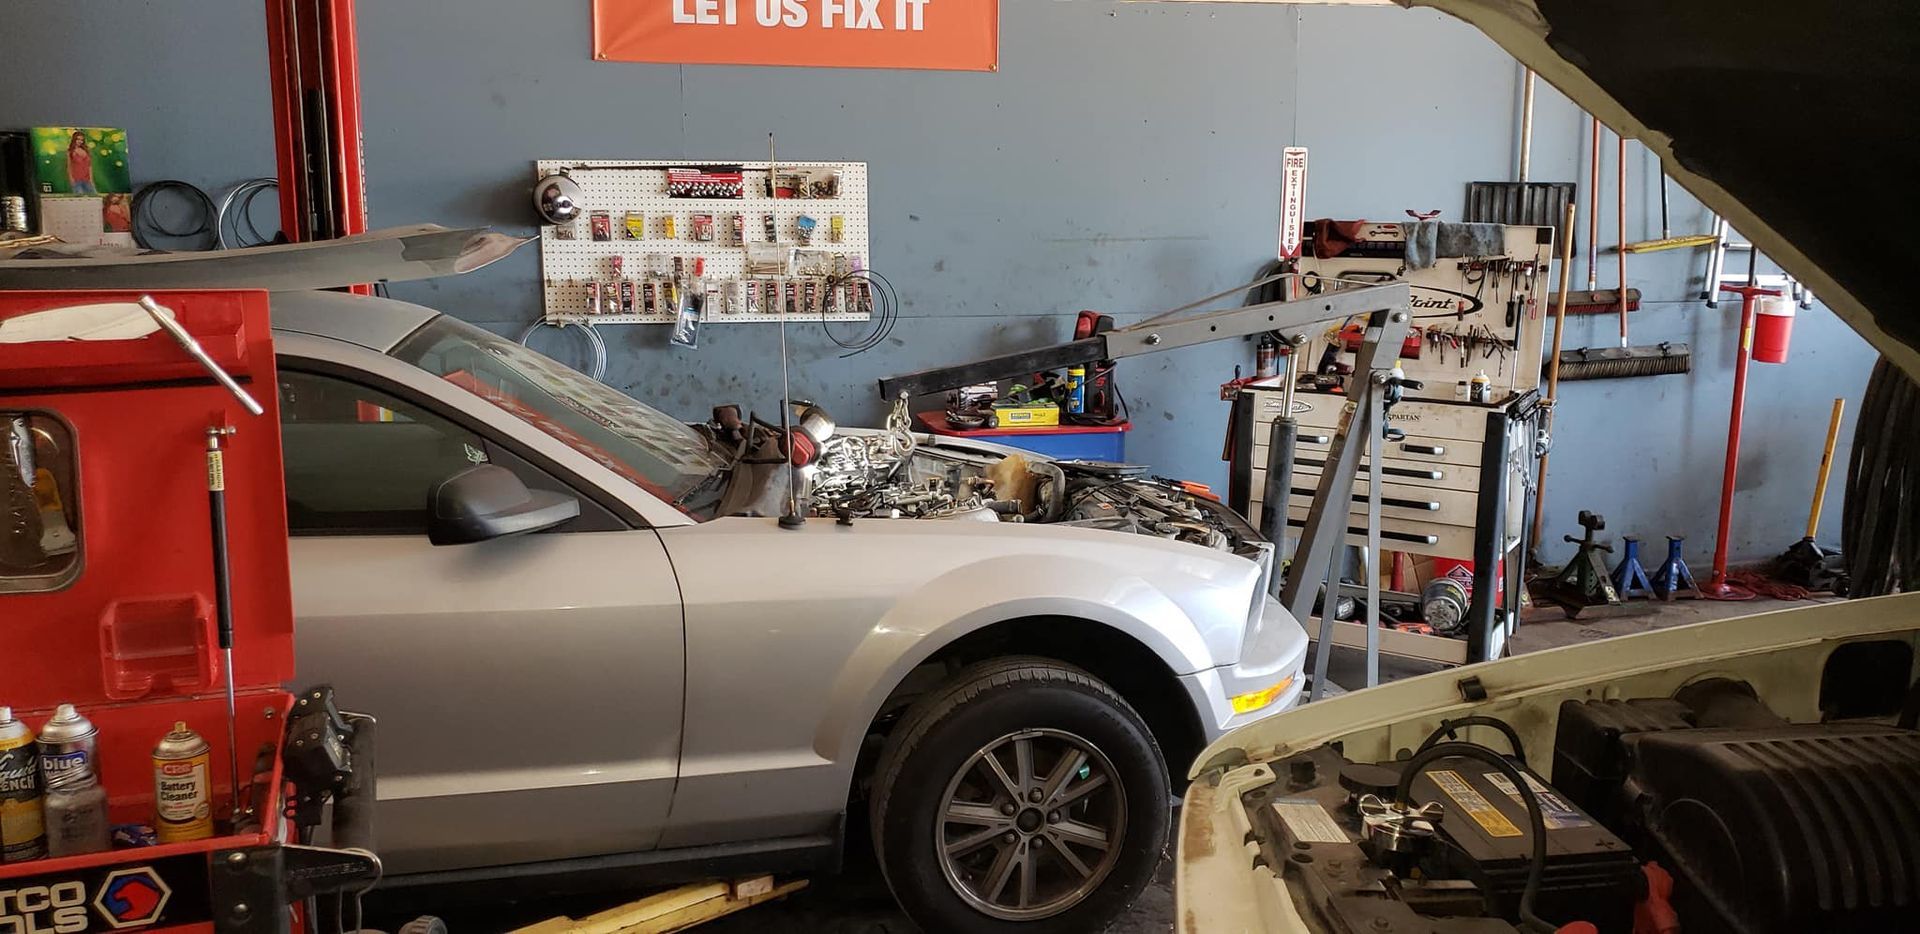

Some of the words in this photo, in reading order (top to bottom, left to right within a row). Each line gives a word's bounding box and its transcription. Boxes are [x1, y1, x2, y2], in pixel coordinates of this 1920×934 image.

[673, 0, 737, 25] LET
[755, 0, 808, 27] US
[821, 0, 884, 30] FIX
[895, 0, 930, 31] IT
[1286, 158, 1304, 168] FIRE
[1287, 170, 1298, 251] EXTINGUISHER
[43, 757, 84, 770] blue
[160, 780, 196, 792] Battery
[160, 790, 199, 801] Cleaner
